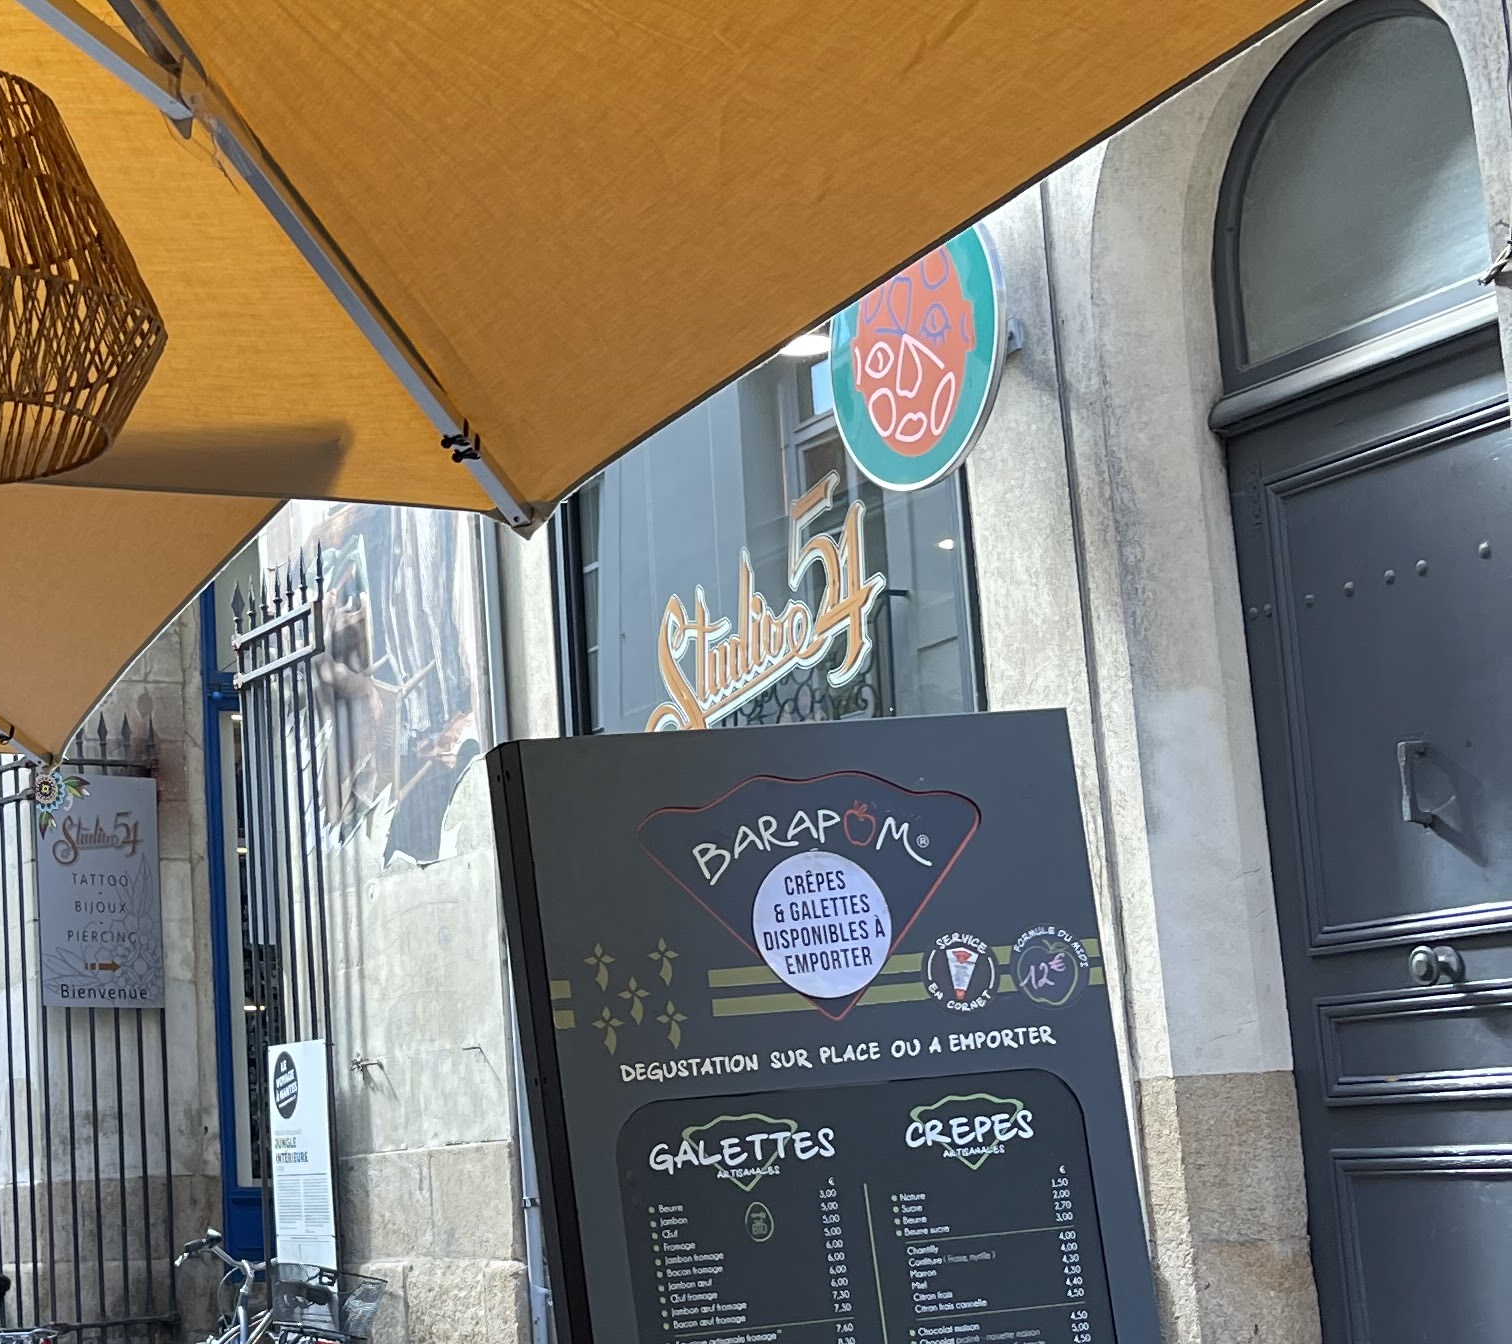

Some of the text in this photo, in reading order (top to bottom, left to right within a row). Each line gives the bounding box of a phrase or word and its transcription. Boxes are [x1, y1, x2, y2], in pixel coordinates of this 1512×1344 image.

[645, 469, 886, 732] Studio 54
[52, 811, 144, 867] Studio 54
[72, 872, 128, 887] TATTOO
[784, 870, 846, 895] CRÊPES
[75, 900, 127, 915] BIJOUX
[774, 893, 870, 923] & GALETTES
[67, 929, 137, 944] PIERCING
[763, 914, 886, 951] DISPONIBLES À
[936, 932, 988, 955] SERVICE
[1013, 926, 1090, 968] FORMULE DU MIDI
[785, 946, 873, 975] EMPORTER
[60, 984, 148, 1000] Bienvenue
[928, 982, 992, 1012] EN CORNET
[619, 1025, 1057, 1084] DEGUSTATION SUR PLACE OU A EMPORTER
[905, 1108, 1035, 1149] CREPES
[648, 1126, 836, 1176] GALETTES
[1051, 1177, 1068, 1187] 1,50
[819, 1188, 836, 1198] 3,00
[899, 1193, 925, 1201] Nature
[1052, 1189, 1070, 1198] 2,00
[820, 1201, 838, 1211] 5,00
[1054, 1200, 1071, 1210] 2,70
[659, 1216, 688, 1227] Jambon
[822, 1213, 840, 1223] 5,00
[1055, 1211, 1073, 1221] 3,00
[1058, 1230, 1076, 1240] 4,00
[663, 1242, 695, 1251] Fromage
[1060, 1241, 1077, 1252] 4,00
[664, 1252, 724, 1265] Jambon fromage
[665, 1268, 691, 1277] Bacon
[667, 1280, 696, 1291] Jambon
[671, 1306, 699, 1317] Jambon
